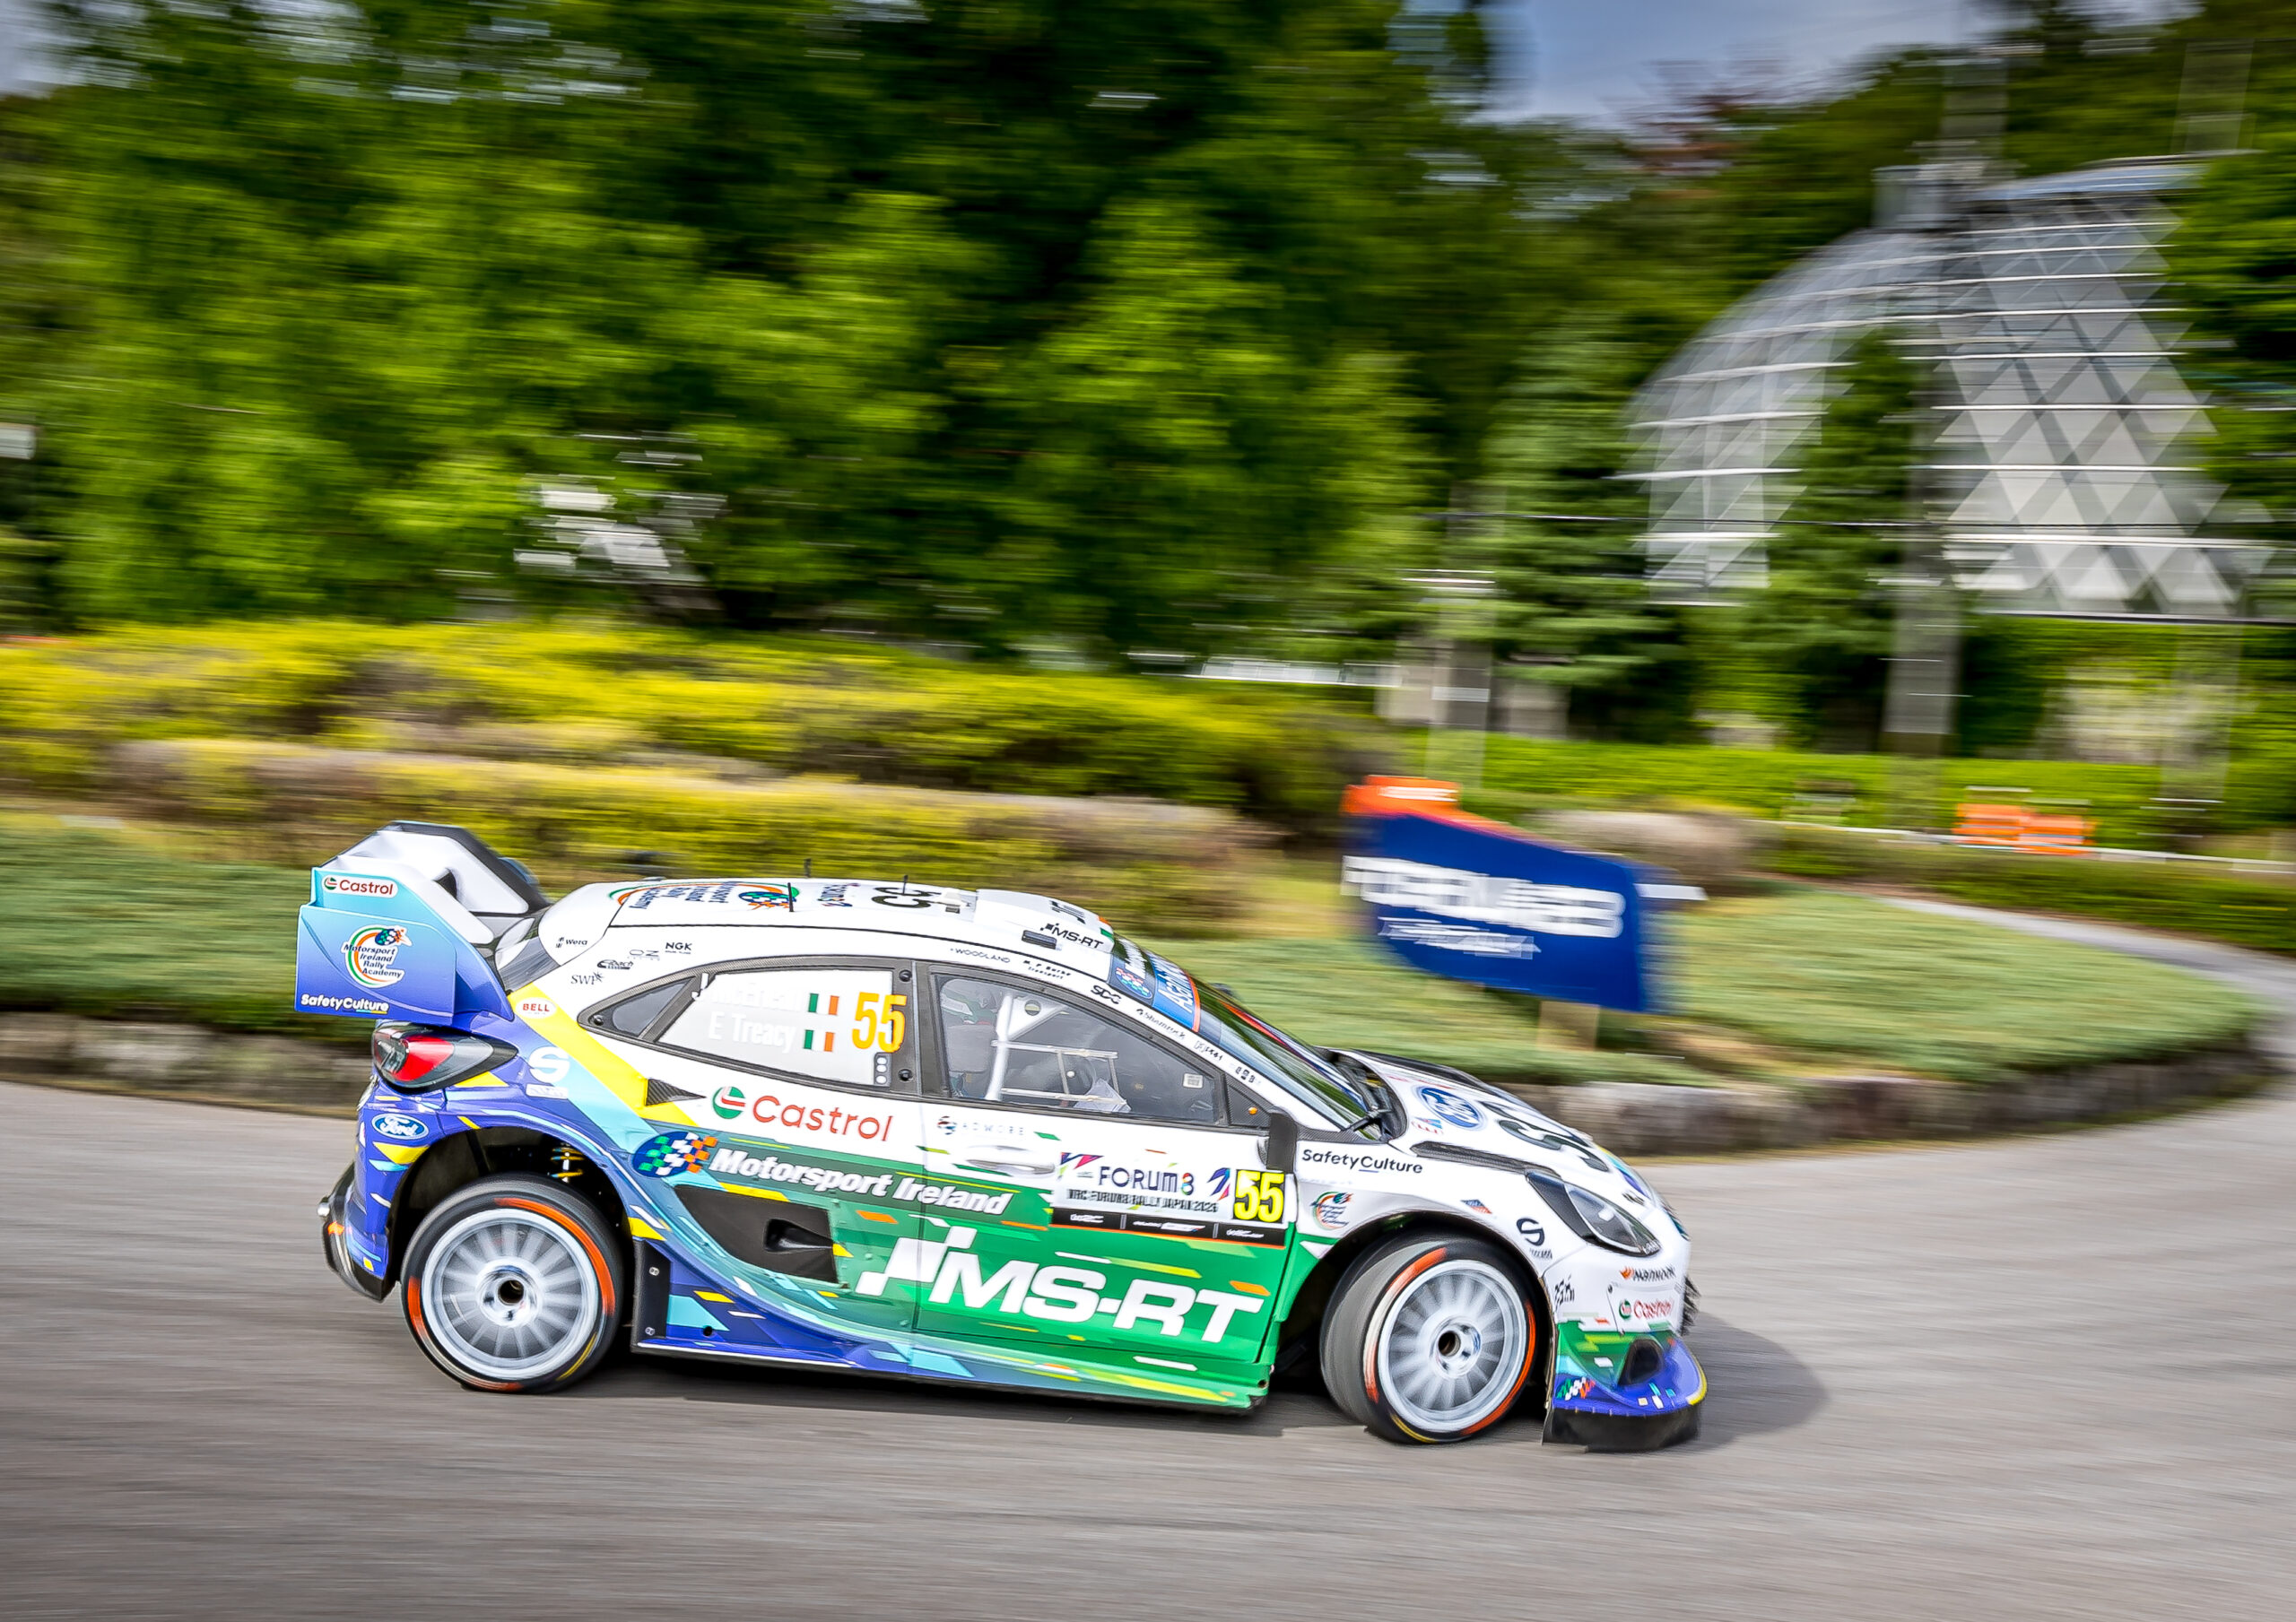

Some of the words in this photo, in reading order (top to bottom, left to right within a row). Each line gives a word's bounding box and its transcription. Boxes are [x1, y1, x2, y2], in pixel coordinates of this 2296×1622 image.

[339, 879, 394, 895] Castrol
[344, 943, 396, 955] Motorsport
[665, 941, 692, 951] NGK
[360, 953, 393, 962] Ireland
[363, 960, 385, 969] Rally
[361, 967, 402, 978] Academy
[300, 993, 389, 1012] SafetyCulture
[523, 1002, 550, 1012] BELL
[709, 1011, 725, 1040] E
[731, 1013, 797, 1054] Treacy
[852, 992, 908, 1053] 55
[752, 1096, 893, 1142] Castrol
[1302, 1149, 1422, 1174] SafetyCulture
[709, 1148, 893, 1193] Motorsport
[892, 1177, 1014, 1215] Ireland
[1099, 1166, 1195, 1196] FORUM8
[1234, 1169, 1285, 1223] 55
[928, 1251, 1265, 1344] MS-RT
